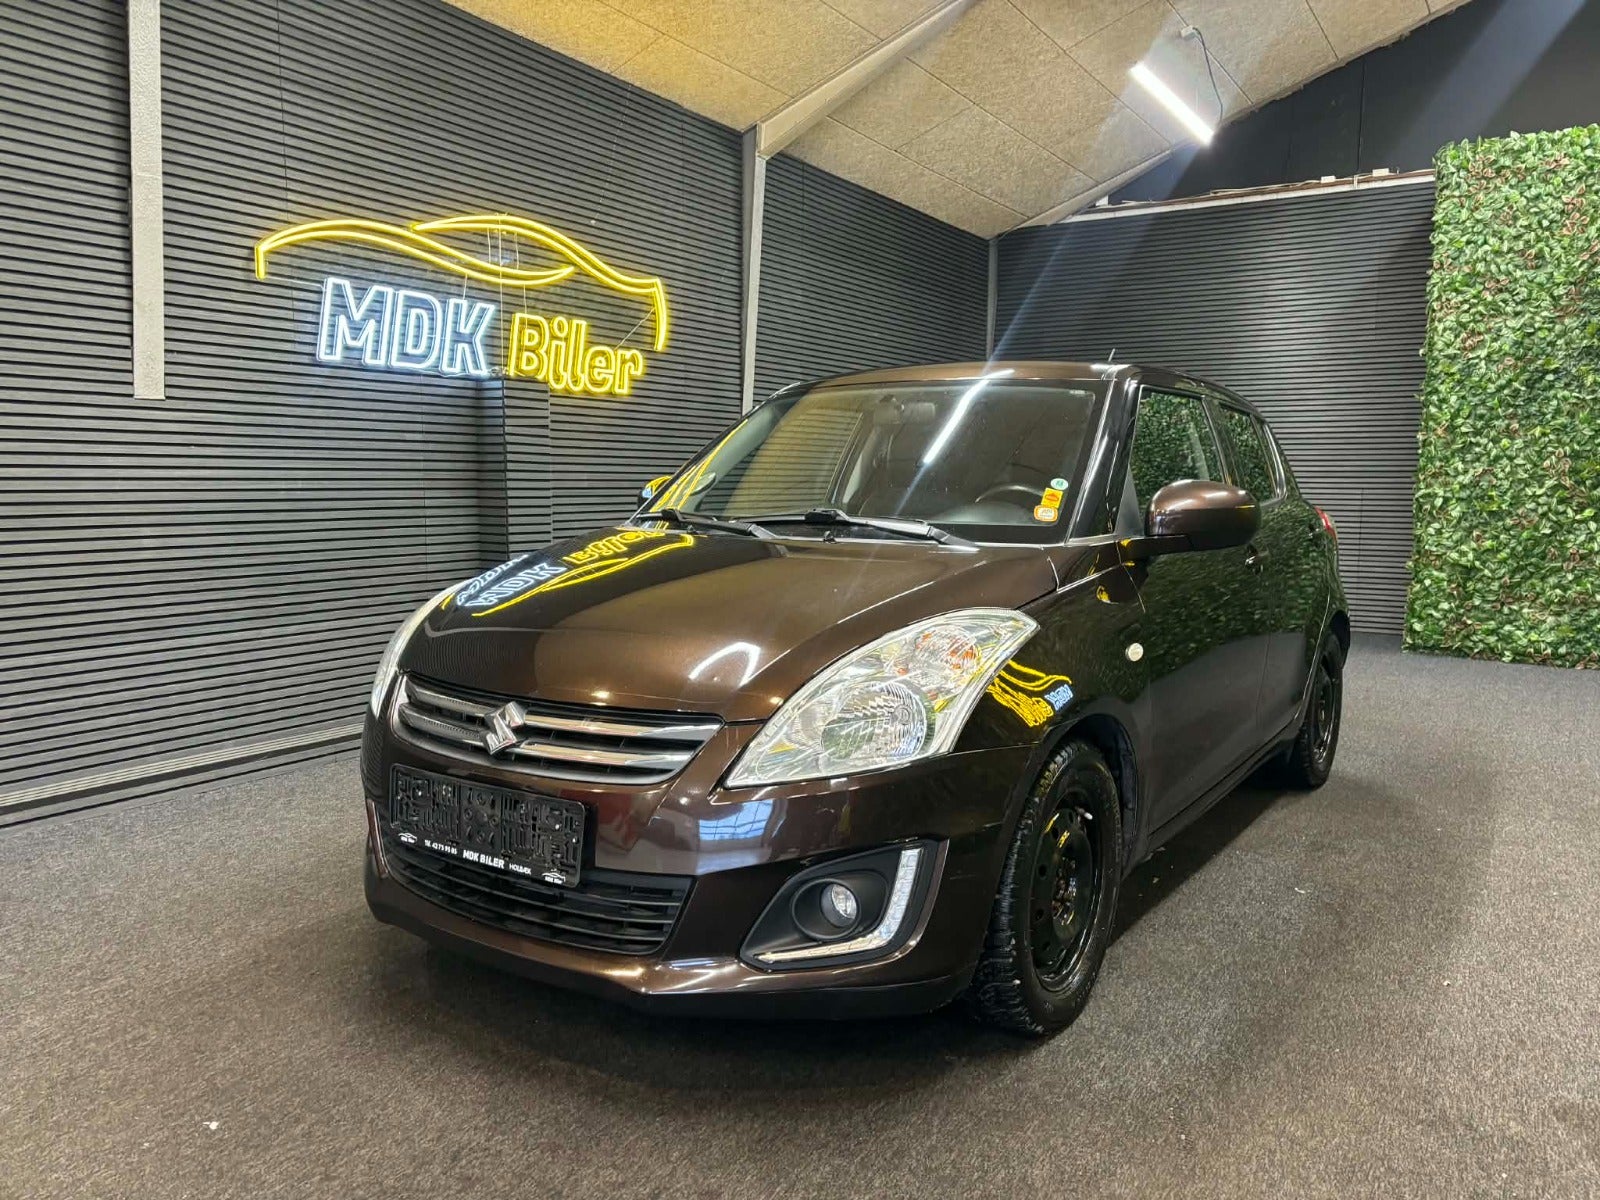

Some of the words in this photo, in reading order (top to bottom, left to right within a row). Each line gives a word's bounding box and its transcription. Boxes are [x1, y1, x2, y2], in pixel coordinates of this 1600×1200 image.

[316, 277, 496, 376] MDK
[508, 312, 643, 394] Biler
[463, 849, 479, 862] MDK
[480, 854, 505, 869] BILER
